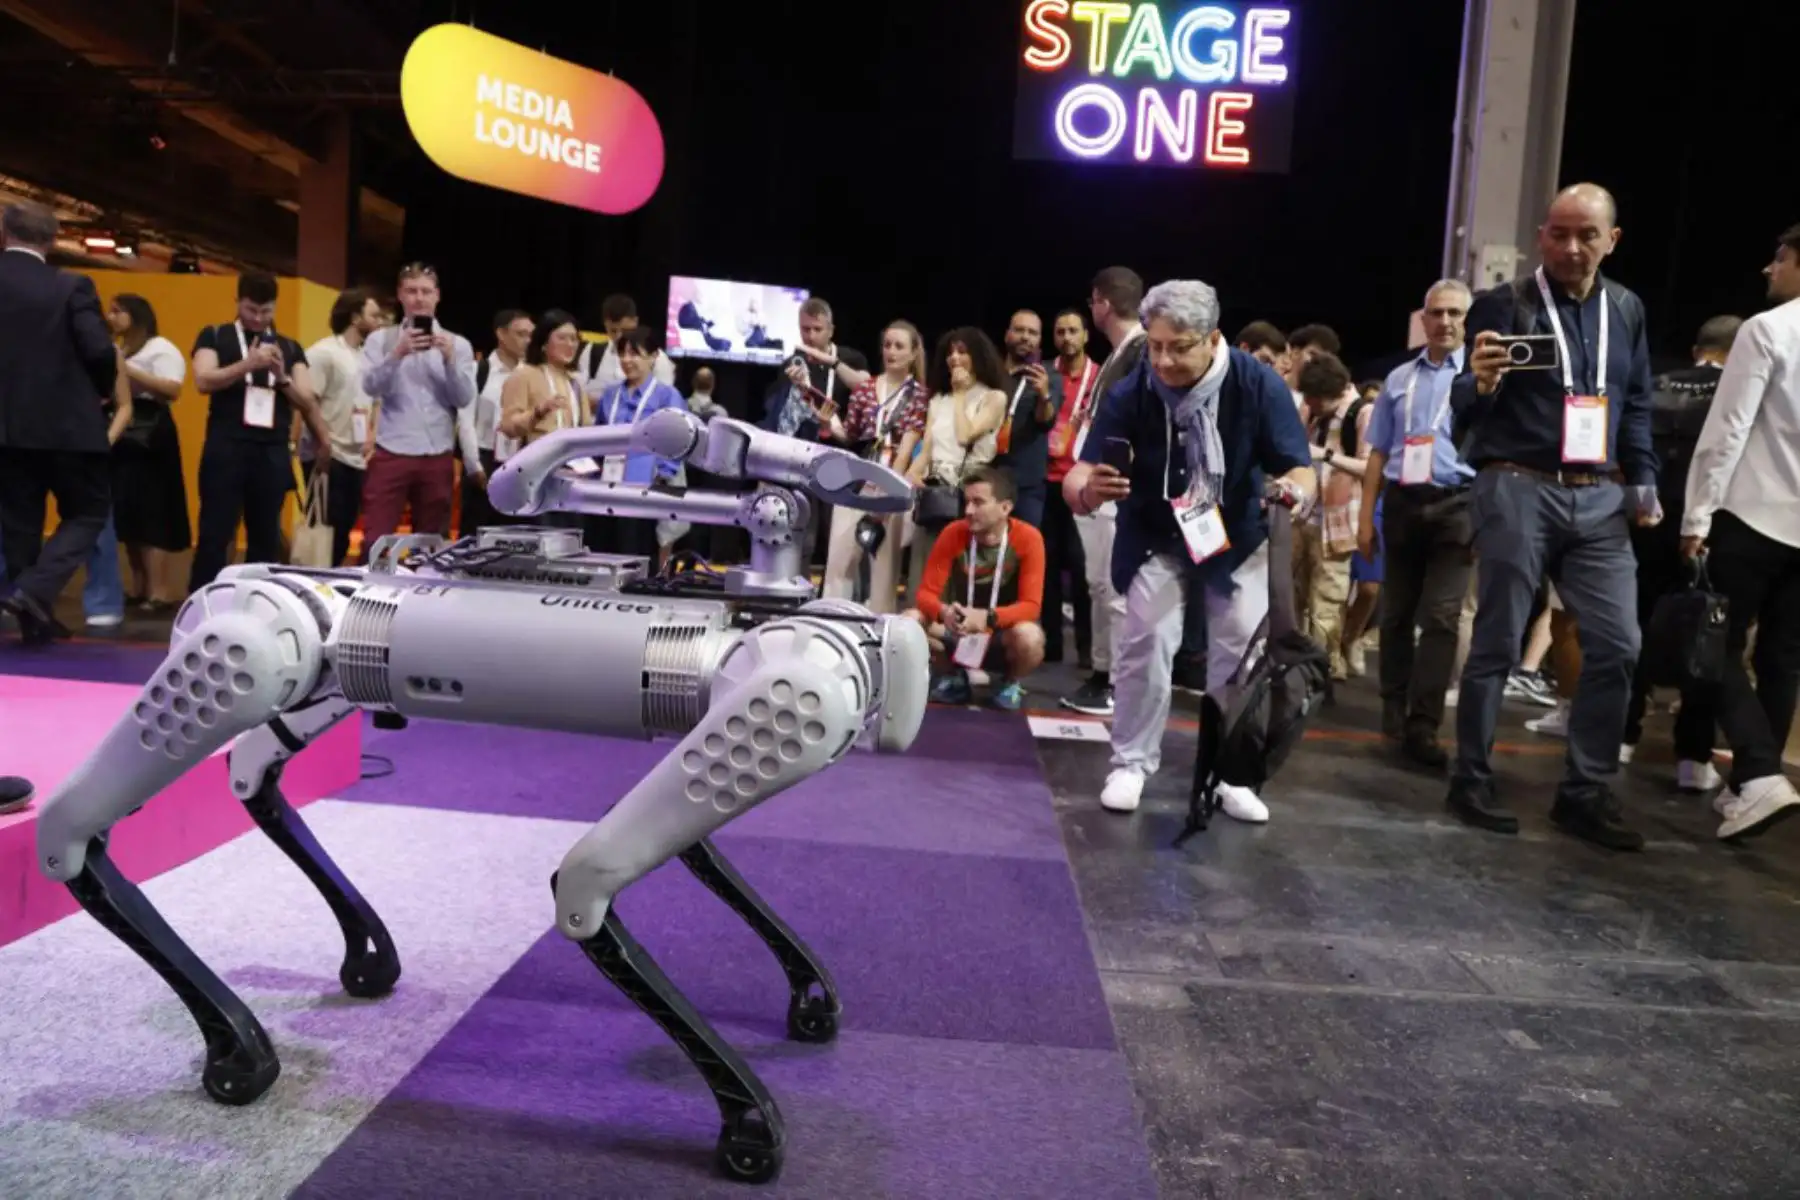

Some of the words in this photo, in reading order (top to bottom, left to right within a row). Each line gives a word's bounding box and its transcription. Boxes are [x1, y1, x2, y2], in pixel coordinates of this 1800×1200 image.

[1024, 0, 1290, 83] STAGE
[477, 73, 574, 131] MEDIA
[1055, 83, 1253, 163] ONE
[475, 110, 602, 173] LOUNGE
[540, 593, 653, 614] Unitree
